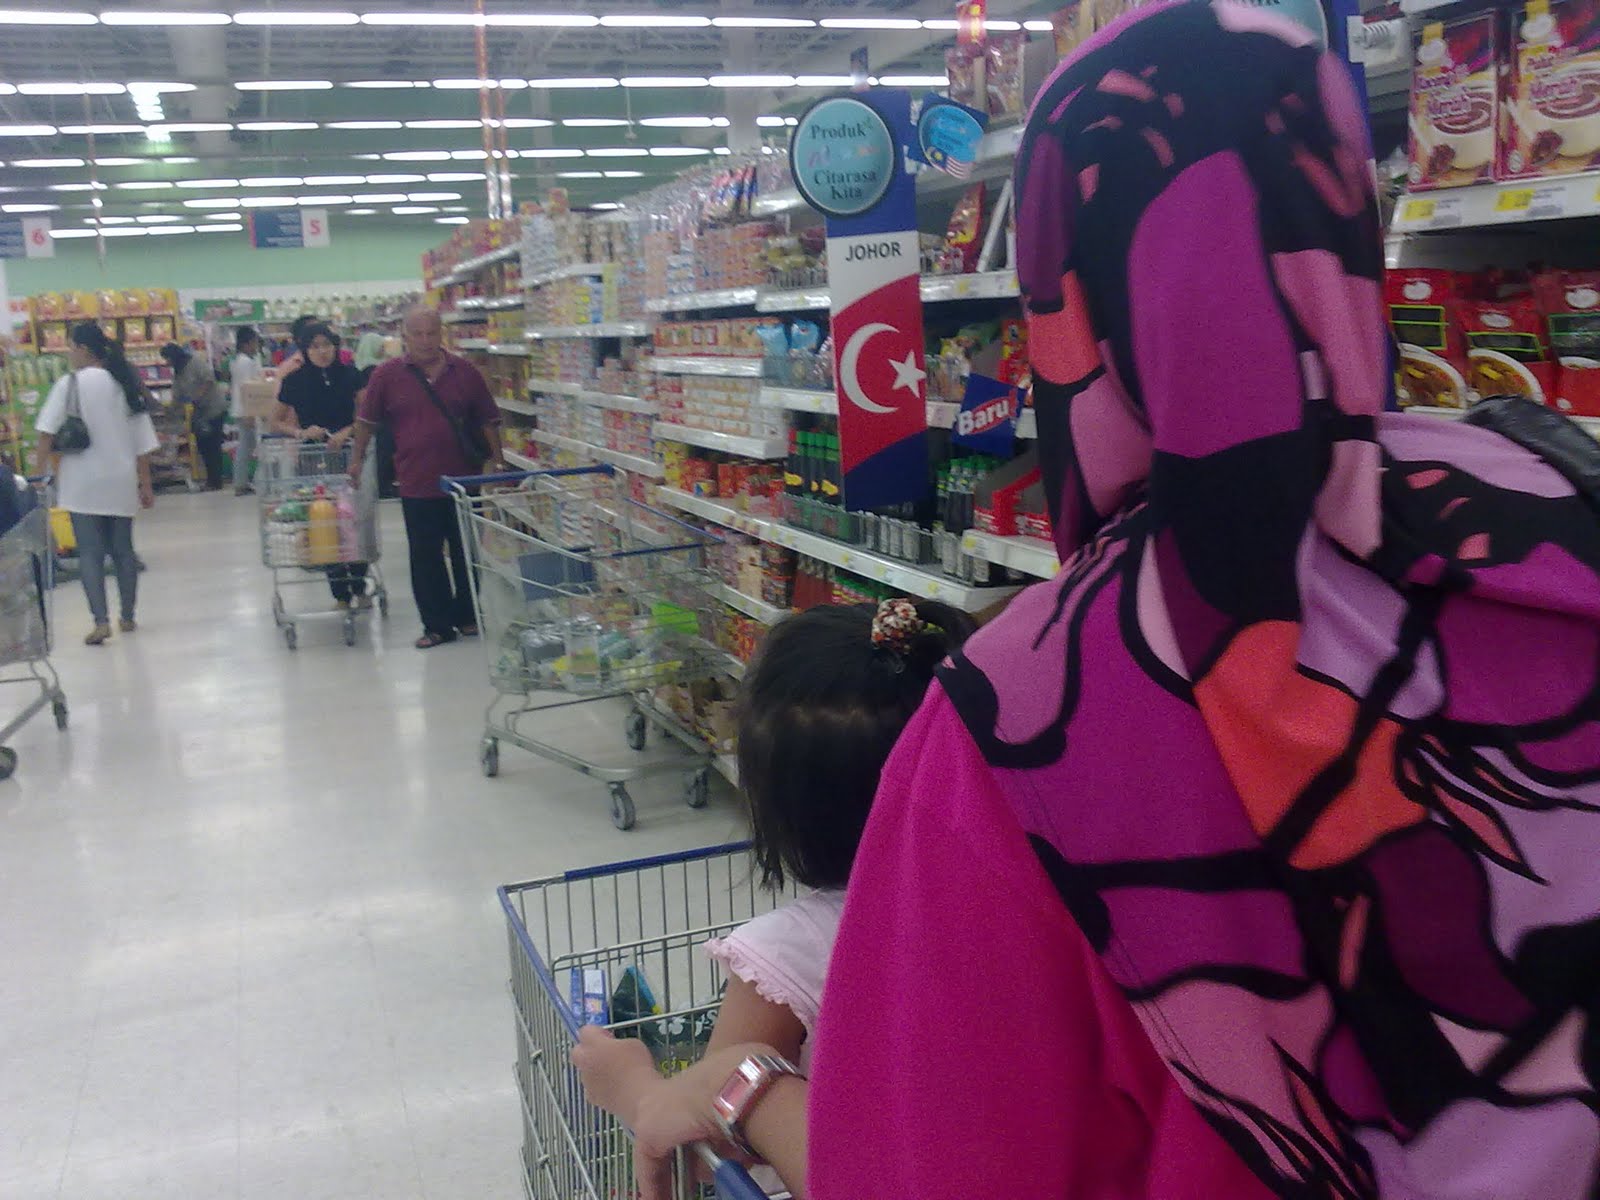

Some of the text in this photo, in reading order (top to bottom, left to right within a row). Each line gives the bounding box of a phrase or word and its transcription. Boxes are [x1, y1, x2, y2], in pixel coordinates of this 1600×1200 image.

[810, 123, 867, 139] Produk
[813, 168, 877, 185] Citarasa
[830, 185, 863, 200] Kita
[309, 218, 321, 236] 5
[846, 241, 902, 262] JOHOR
